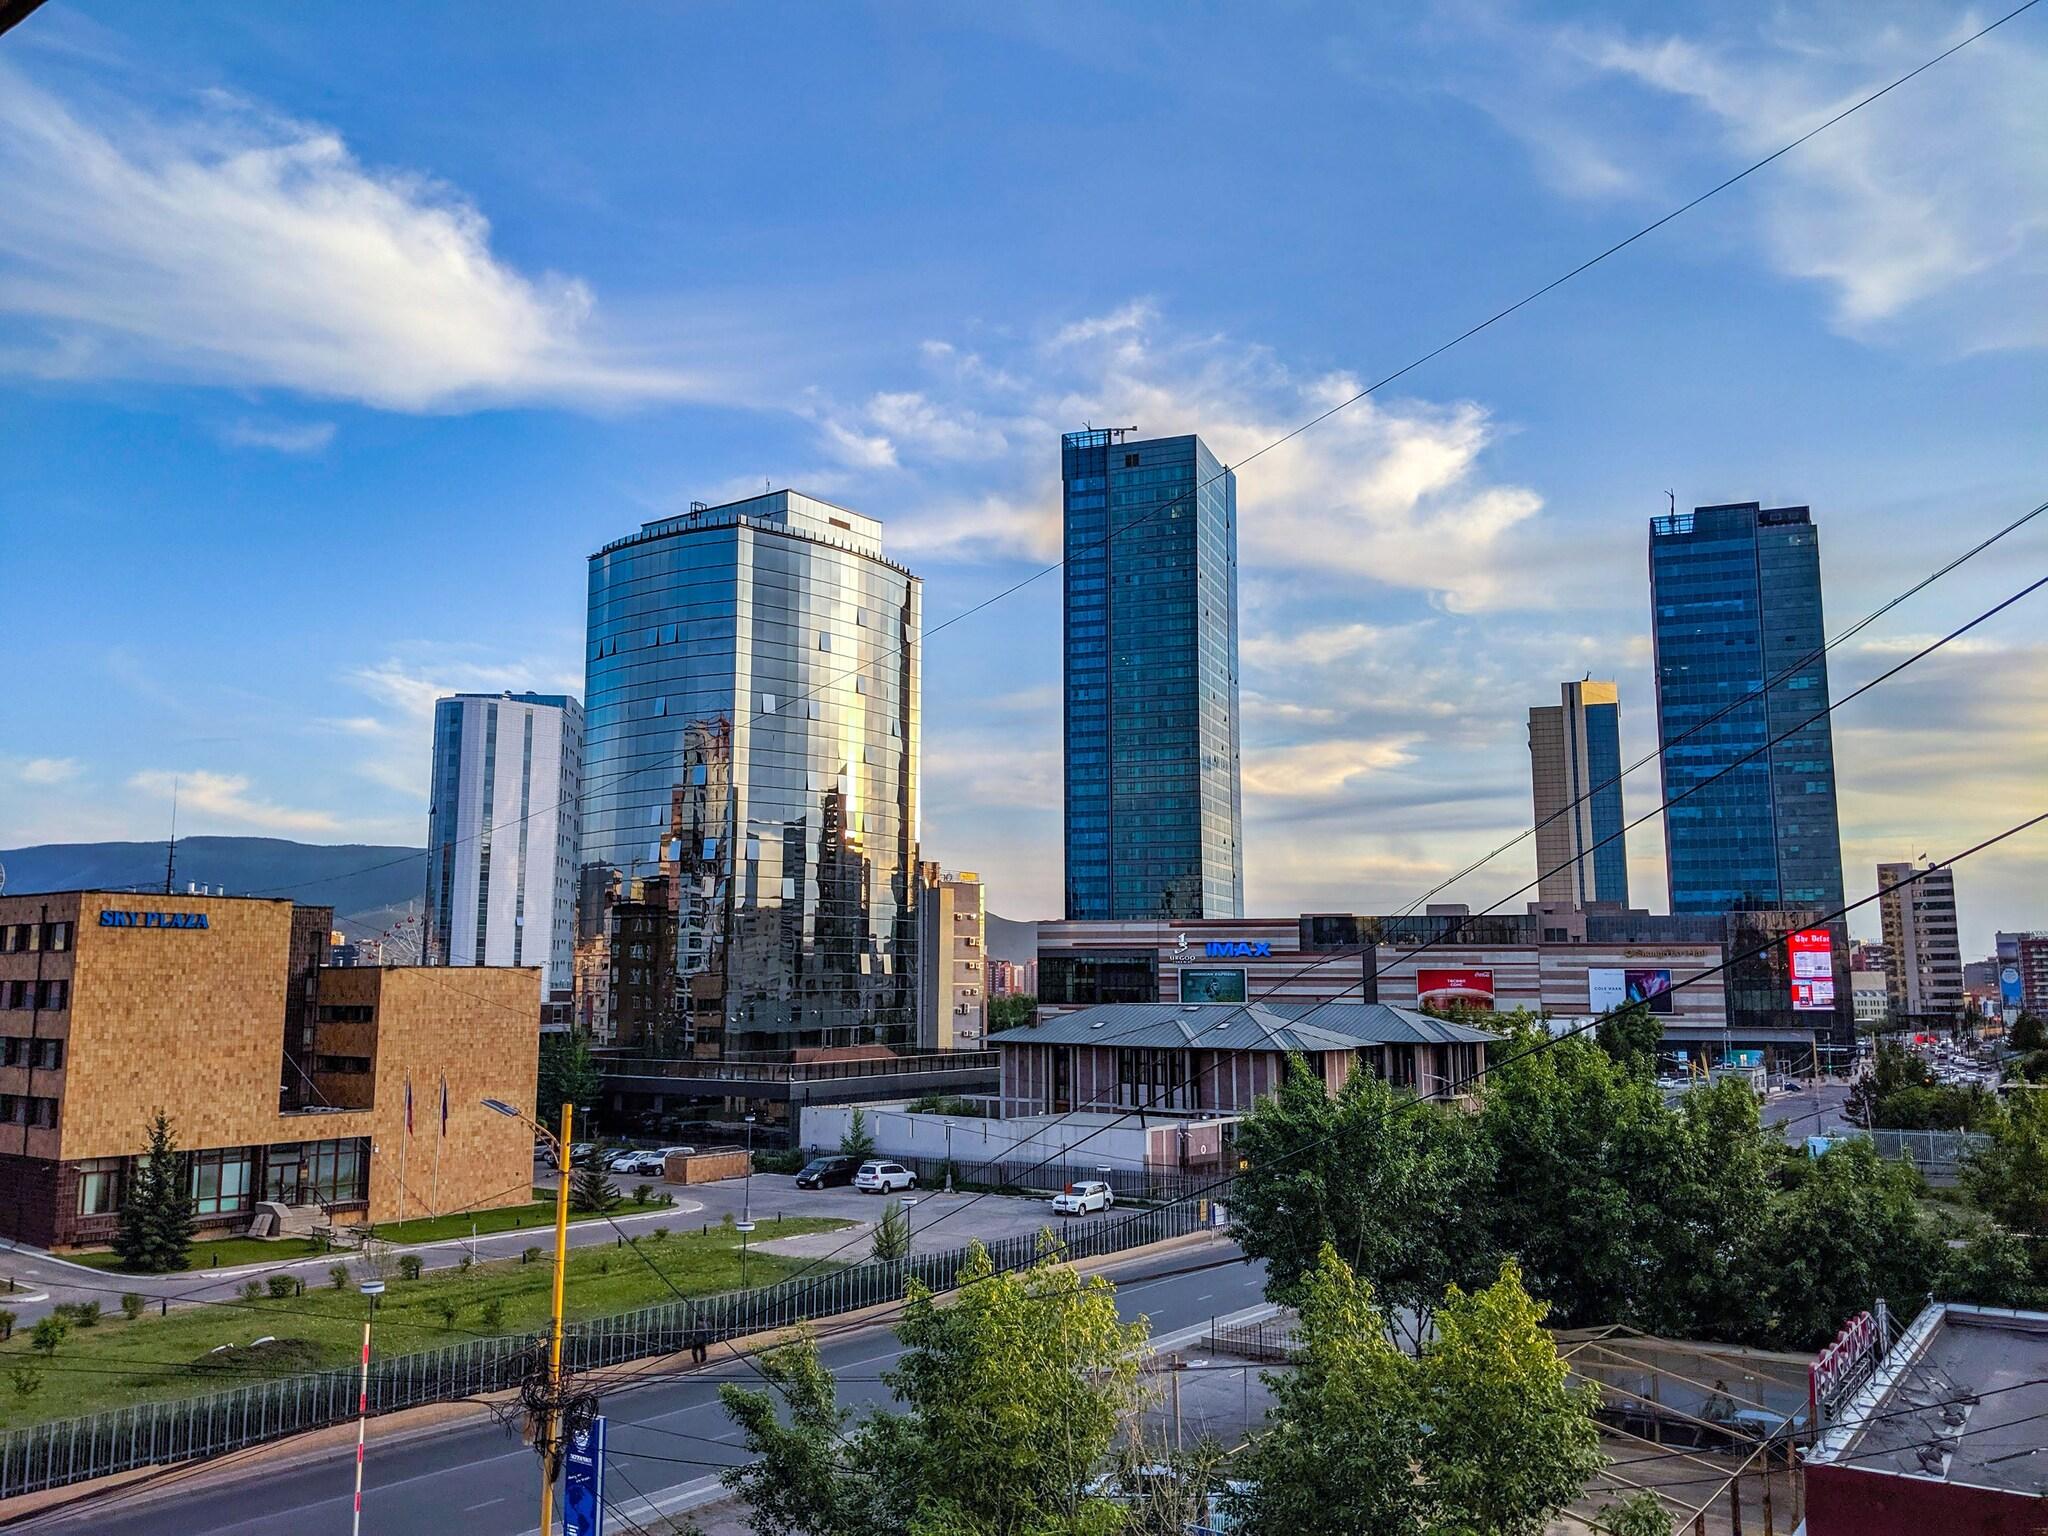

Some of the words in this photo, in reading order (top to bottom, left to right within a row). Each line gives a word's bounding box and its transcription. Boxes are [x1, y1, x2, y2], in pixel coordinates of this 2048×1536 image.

[100, 910, 138, 927] SKY
[145, 912, 209, 929] PLAZA
[1794, 935, 1808, 943] The
[1205, 942, 1272, 958] IMAX
